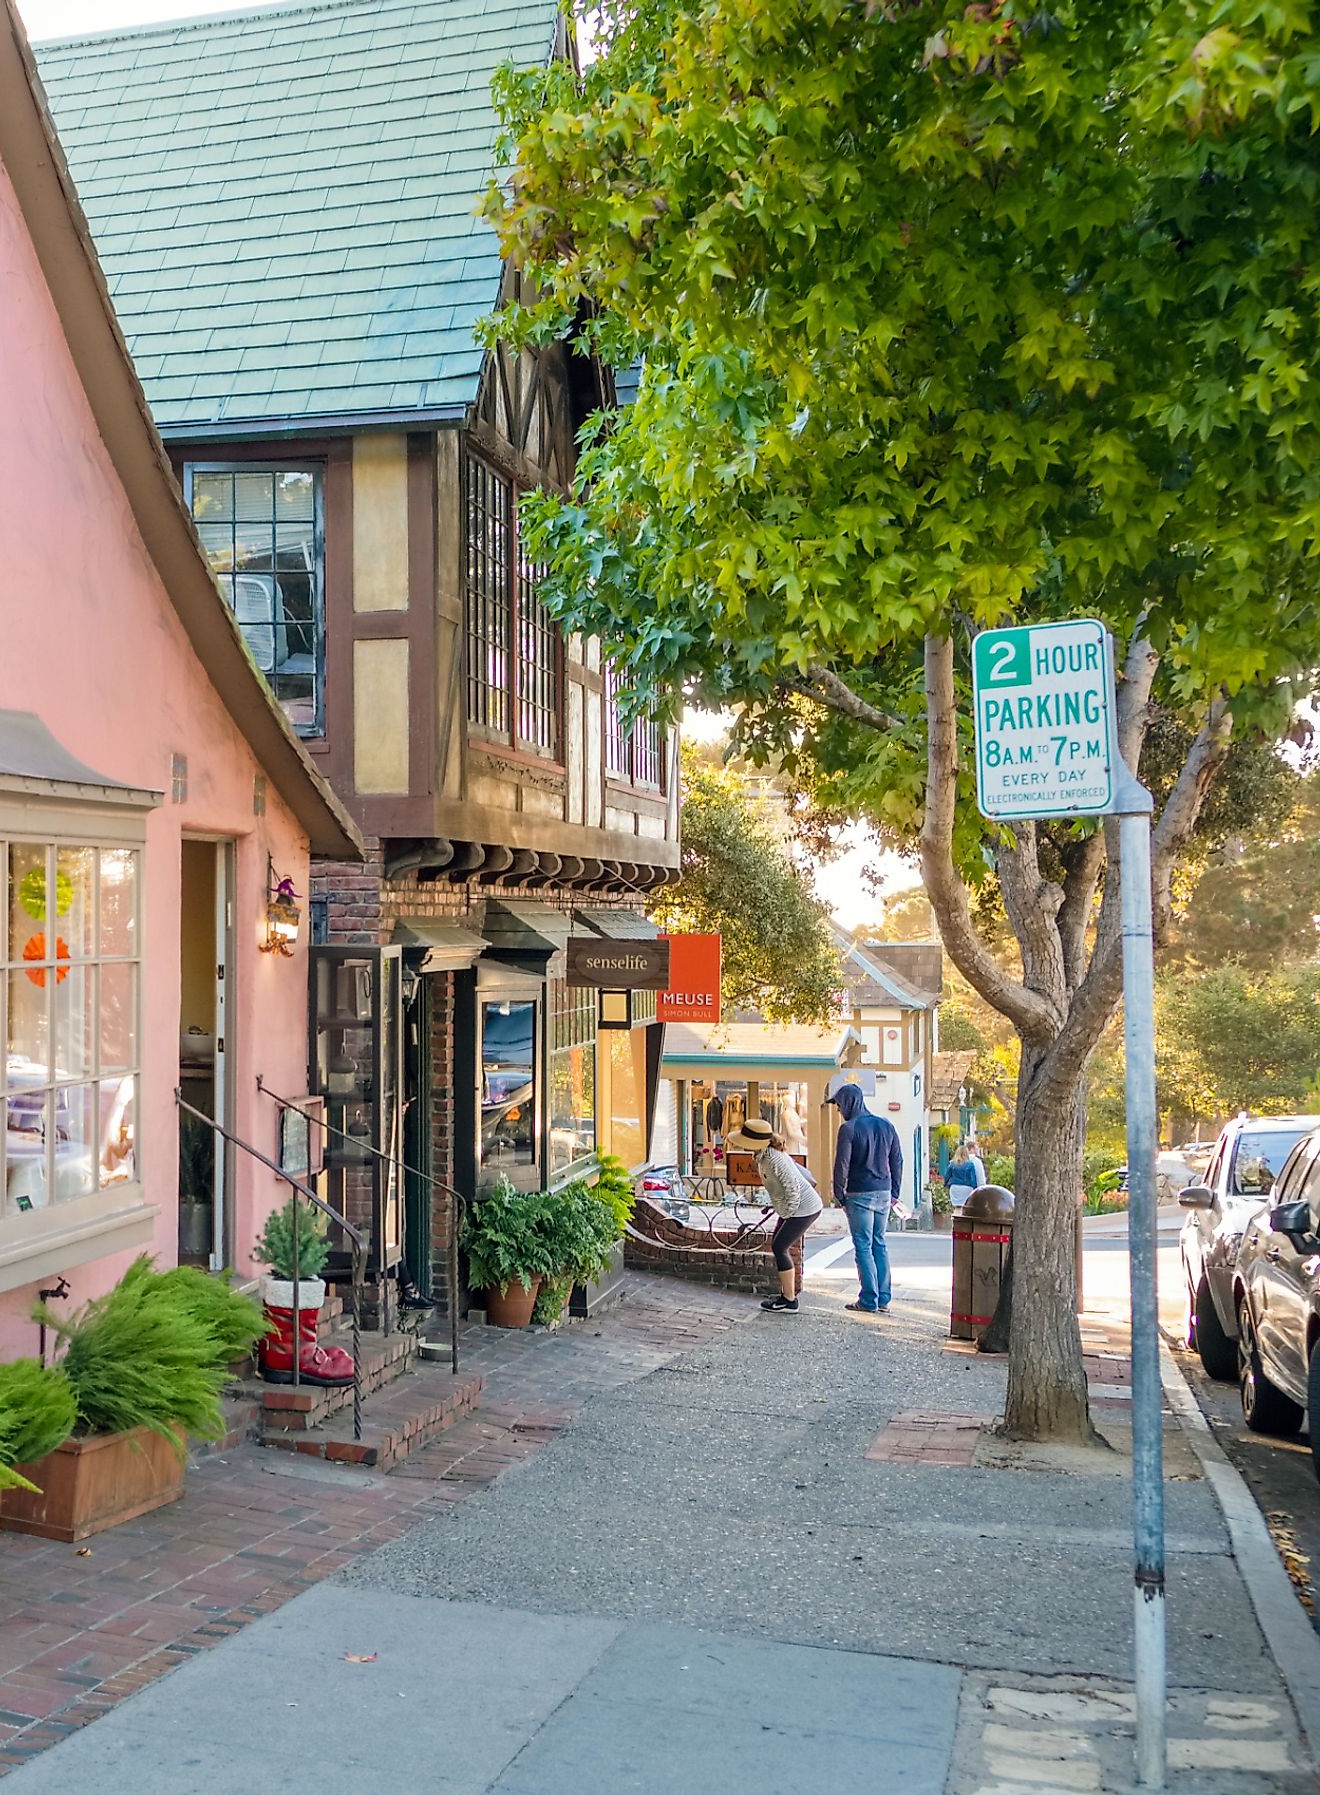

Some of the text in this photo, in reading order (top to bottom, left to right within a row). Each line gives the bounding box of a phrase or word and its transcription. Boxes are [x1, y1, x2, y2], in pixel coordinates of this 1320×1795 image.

[989, 641, 1098, 681] 2 HOUR
[985, 689, 1100, 732] PARKING
[1002, 769, 1087, 787] EVERY DAY
[987, 788, 1105, 805] ELECTRONICALLY ENFORCED
[586, 954, 648, 970] senselife
[663, 993, 713, 1006] MEUSE
[663, 1010, 712, 1018] SIMON BULL
